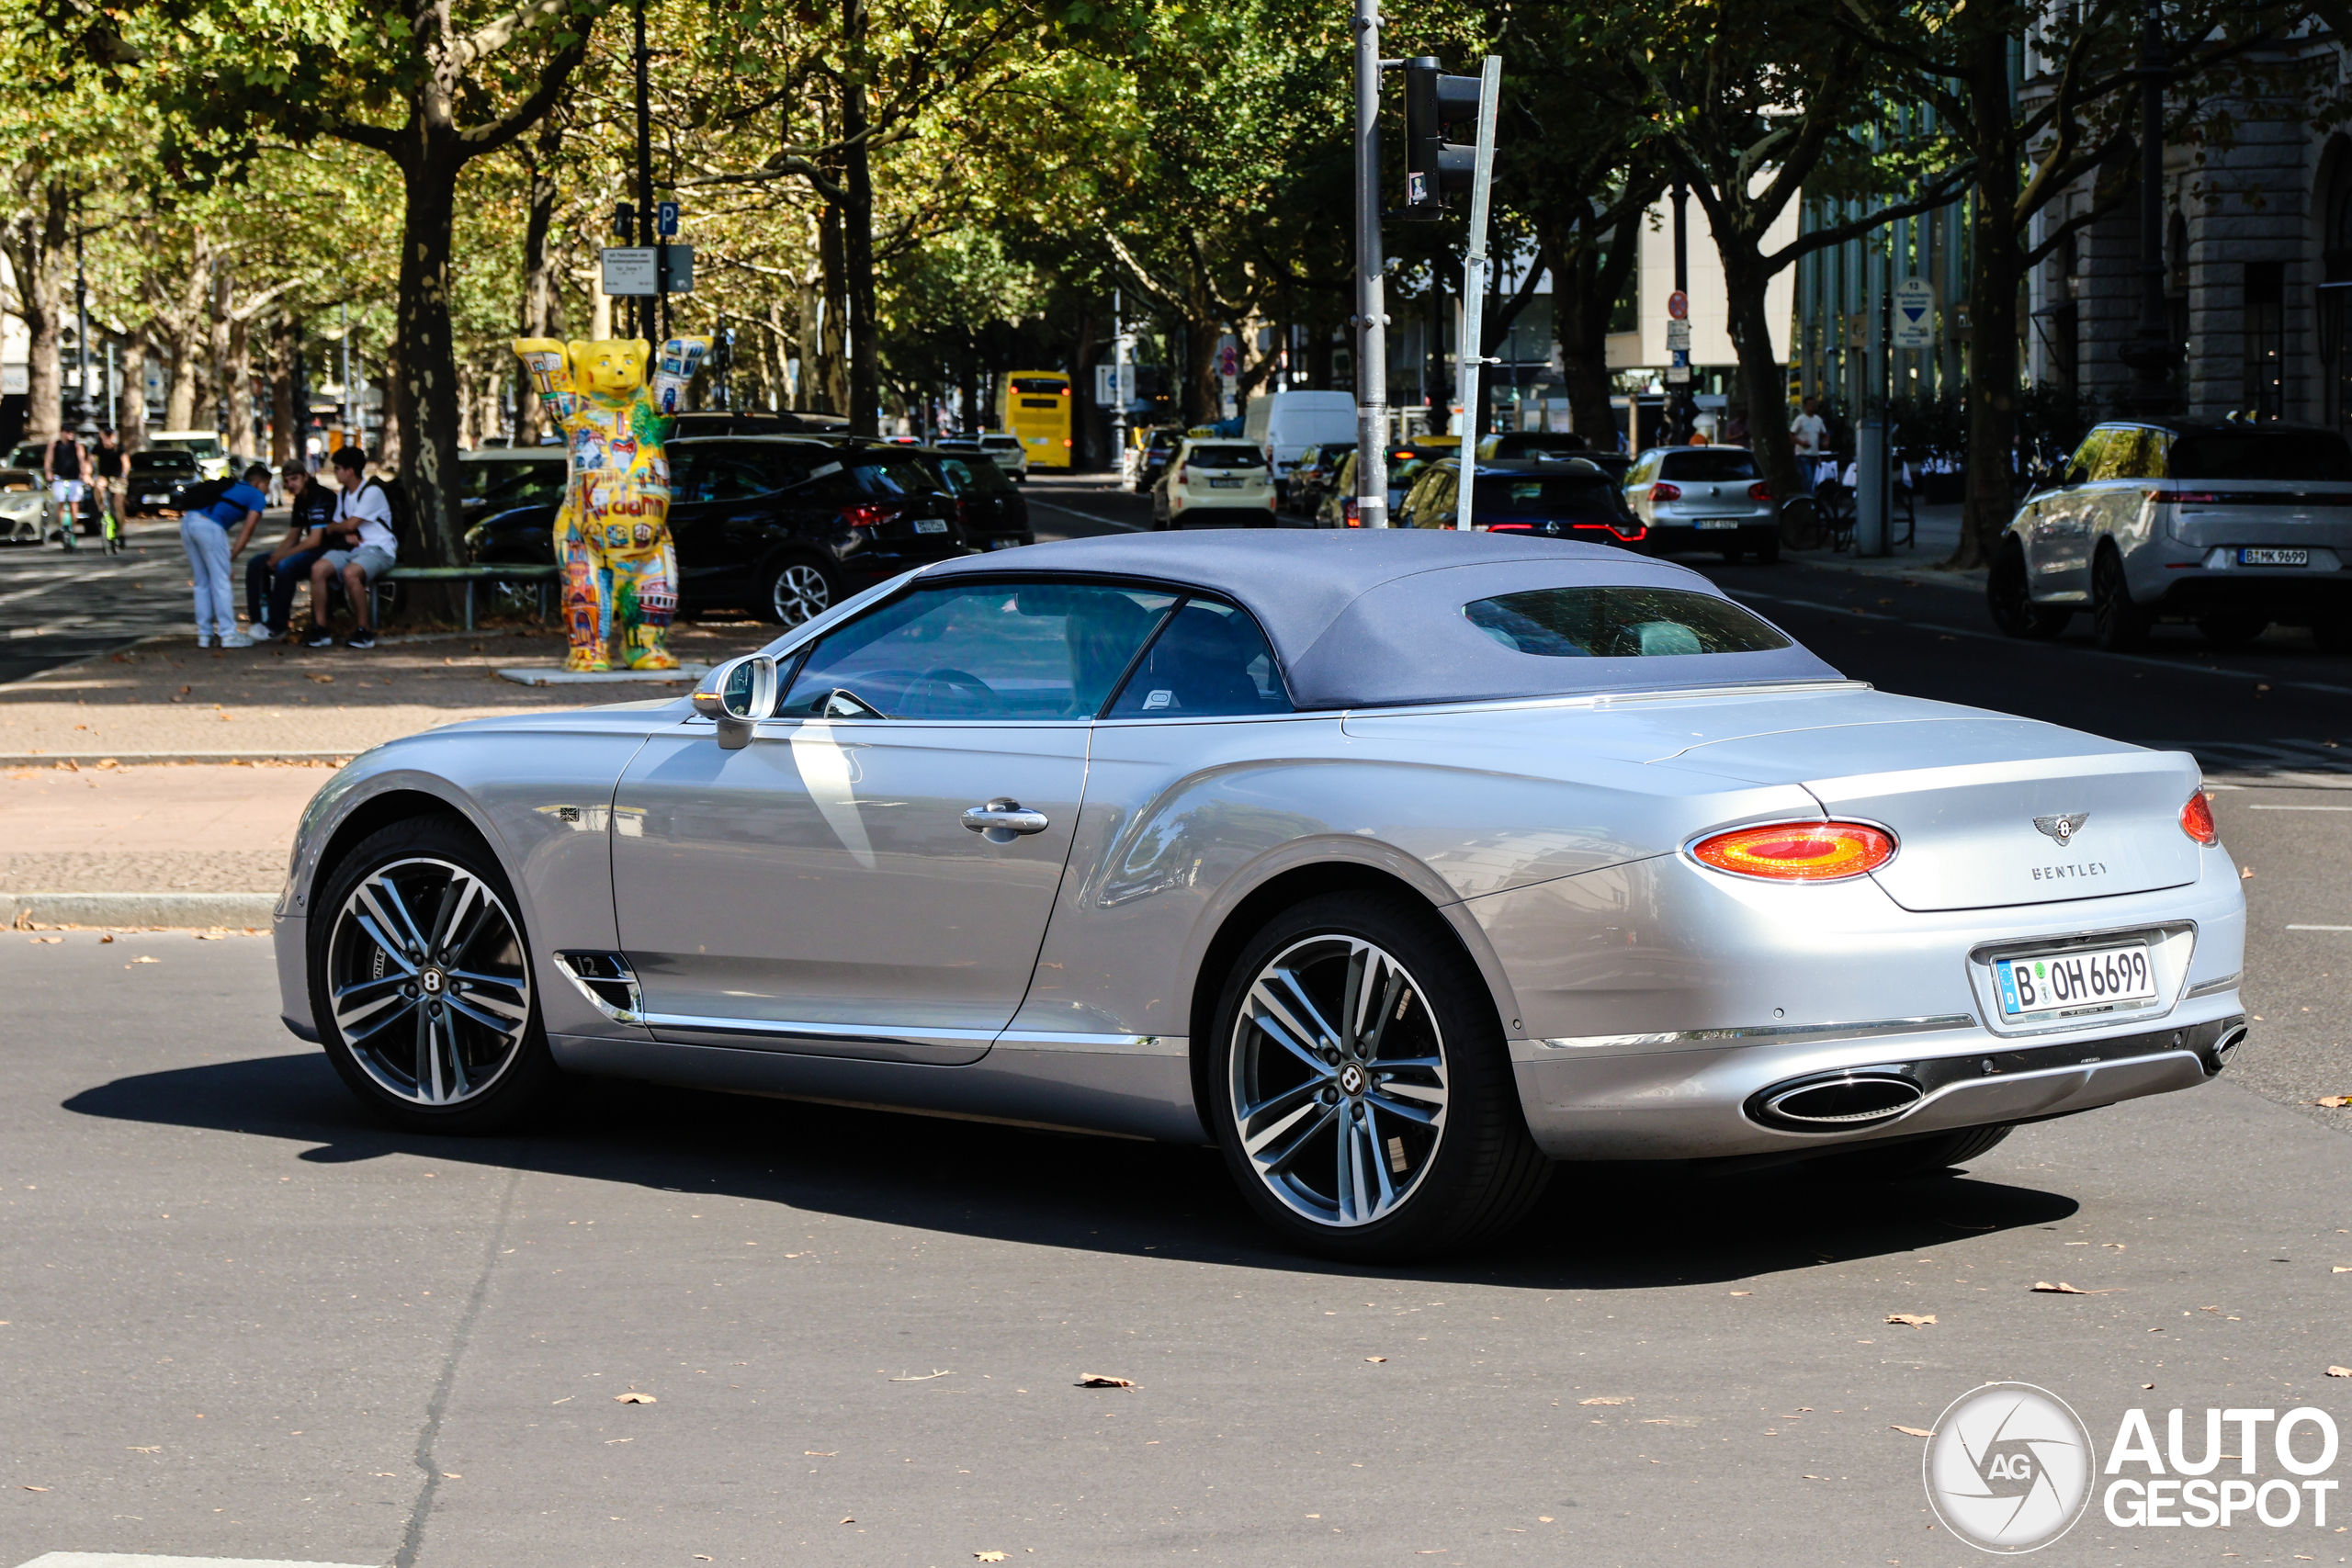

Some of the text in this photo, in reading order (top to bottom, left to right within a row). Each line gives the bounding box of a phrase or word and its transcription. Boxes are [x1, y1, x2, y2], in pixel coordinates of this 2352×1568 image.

[662, 206, 674, 231] P
[2246, 551, 2305, 562] B MK 9699
[2032, 862, 2108, 880] BENTLEY
[424, 972, 440, 991] B
[2007, 952, 2147, 1006] D B OH 6699
